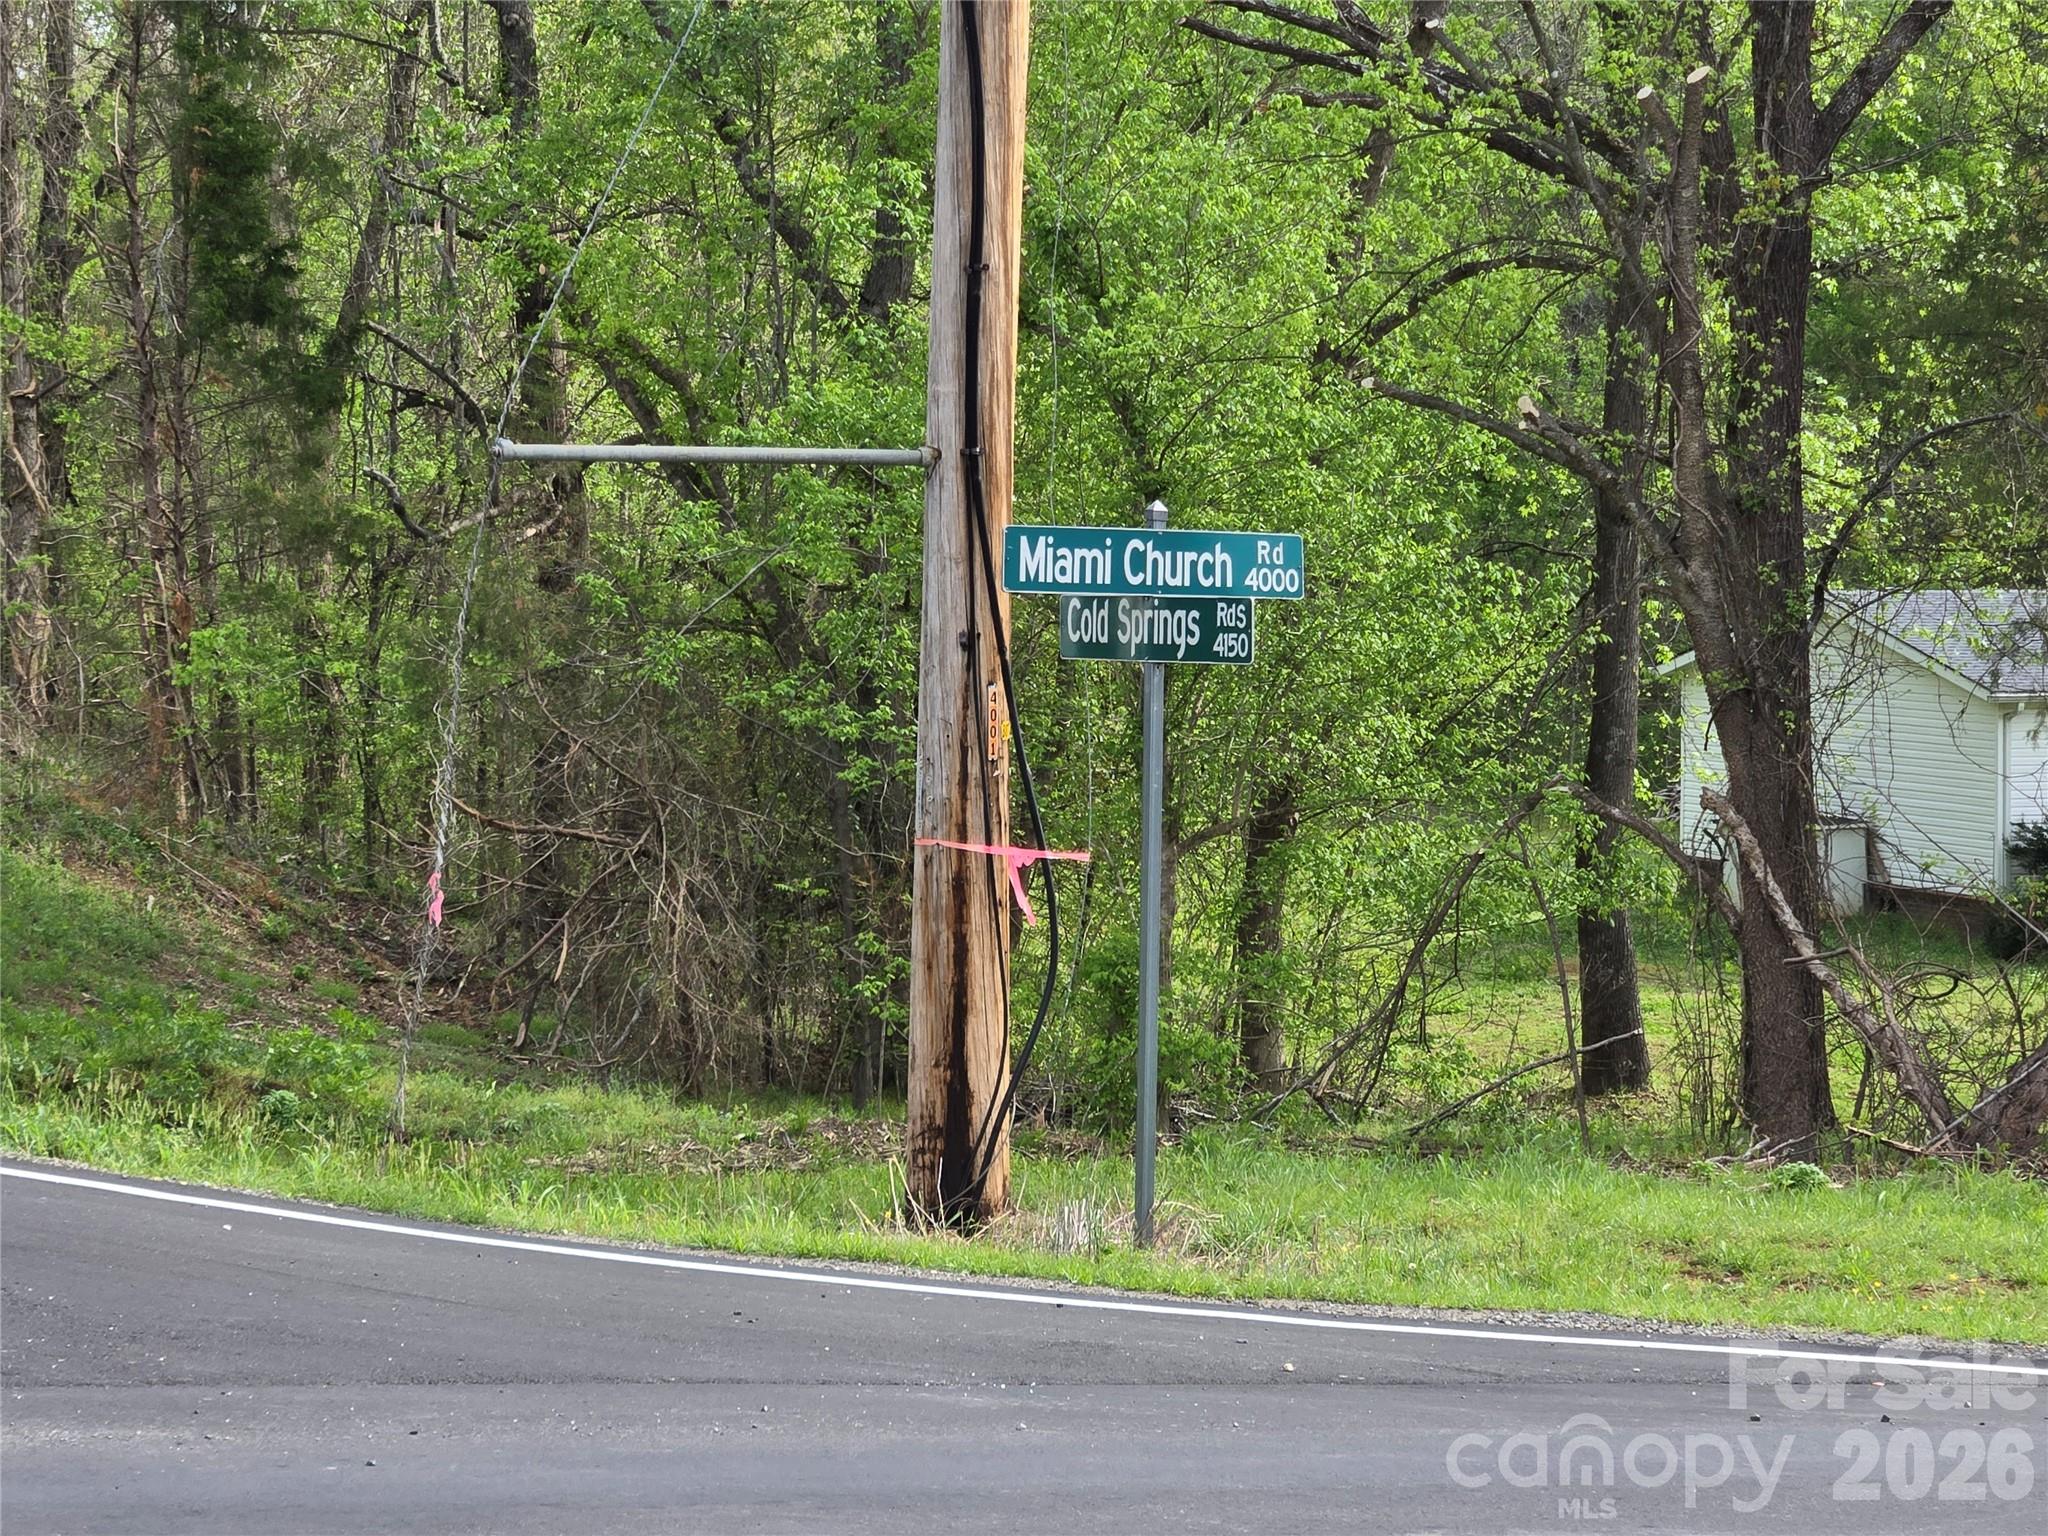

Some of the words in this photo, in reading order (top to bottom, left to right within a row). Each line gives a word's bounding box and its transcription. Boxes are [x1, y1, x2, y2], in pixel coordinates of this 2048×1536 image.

[1018, 535, 1112, 586] Miami
[1123, 538, 1233, 589] Church
[1257, 540, 1284, 566] Rd
[1244, 567, 1300, 593] 4000
[1067, 597, 1109, 644] Cold
[1116, 598, 1201, 660] Springs
[1212, 632, 1249, 658] 4150
